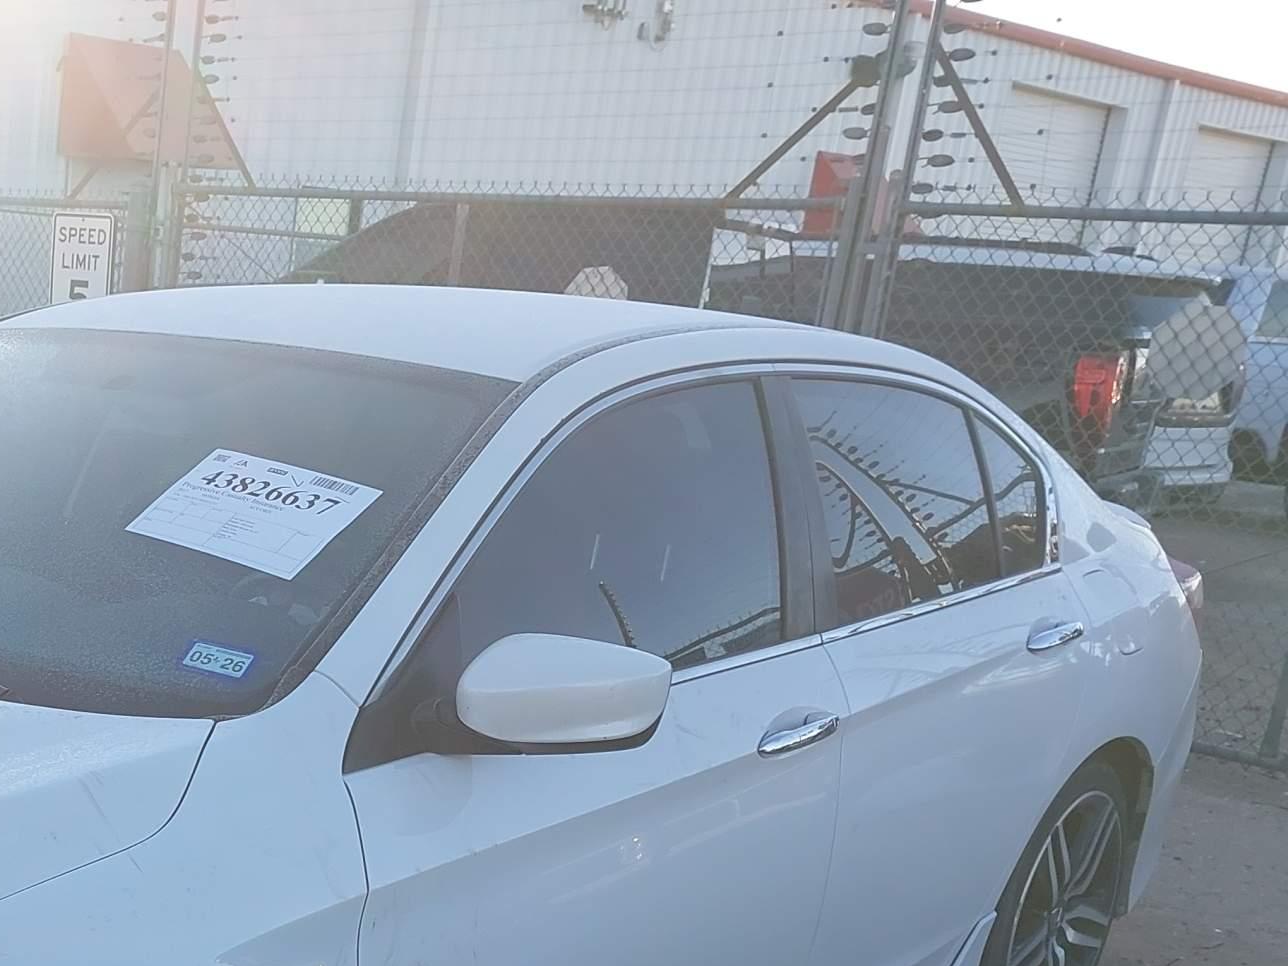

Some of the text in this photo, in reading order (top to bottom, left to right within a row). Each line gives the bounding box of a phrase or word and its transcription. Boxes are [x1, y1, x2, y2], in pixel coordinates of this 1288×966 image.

[58, 226, 107, 246] SPEED
[62, 252, 100, 272] LIMIT
[201, 470, 342, 515] 43826637
